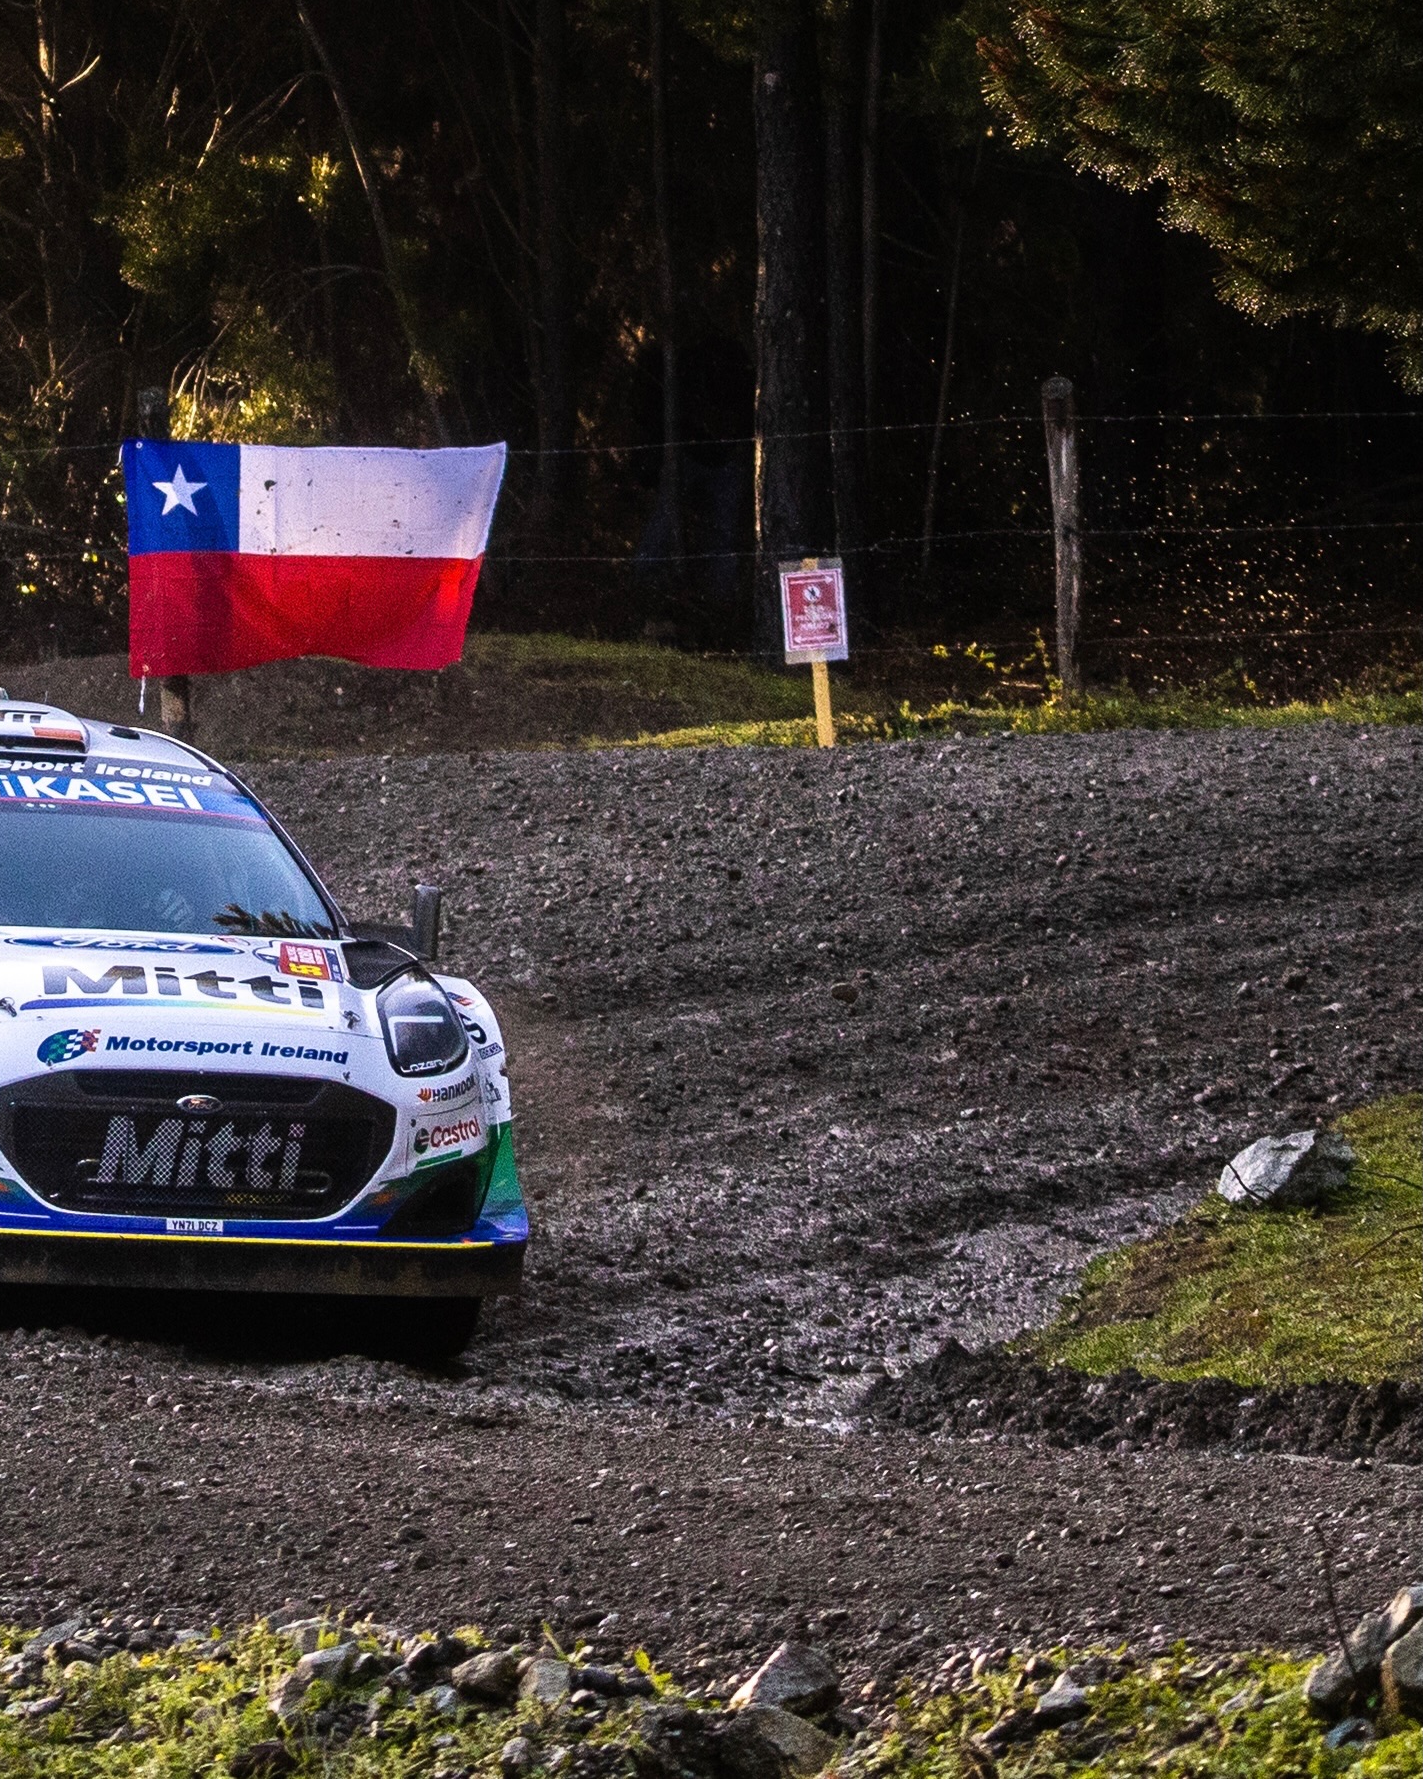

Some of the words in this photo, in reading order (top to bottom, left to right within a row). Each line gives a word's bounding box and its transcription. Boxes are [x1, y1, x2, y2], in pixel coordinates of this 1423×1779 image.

[94, 763, 213, 787] Ireland
[53, 935, 199, 952] Ford
[42, 965, 325, 1009] Mitti
[105, 1035, 253, 1056] Motorsport
[261, 1042, 349, 1064] Ireland
[430, 1115, 481, 1148] Castrol
[96, 1115, 307, 1190] Mitti
